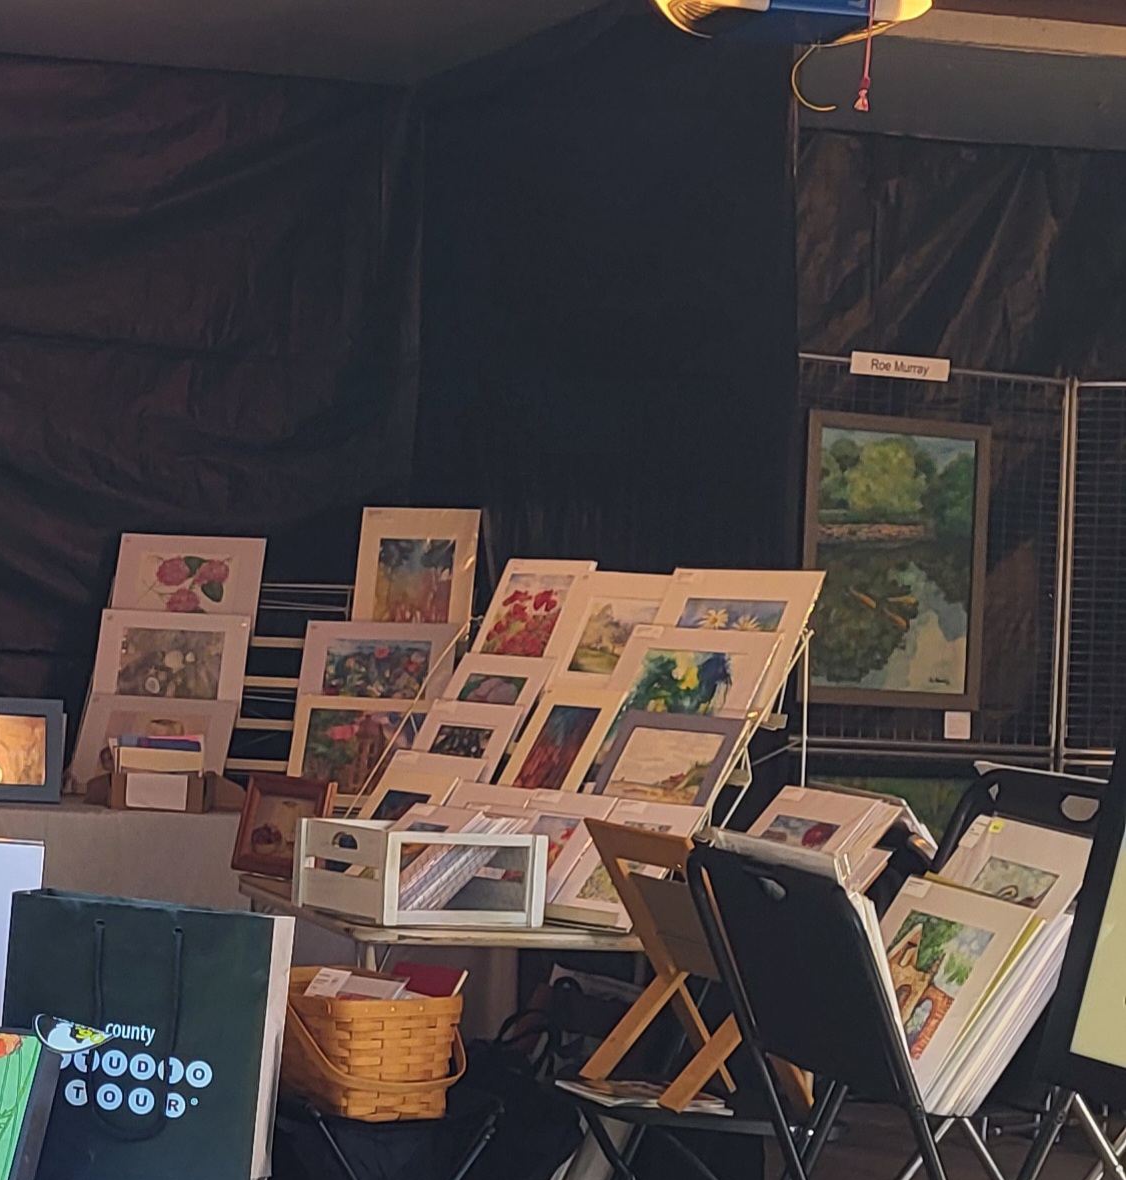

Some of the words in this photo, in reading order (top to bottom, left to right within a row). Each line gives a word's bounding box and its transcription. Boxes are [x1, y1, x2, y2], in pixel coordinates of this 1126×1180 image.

[871, 359, 891, 371] Roe
[895, 361, 929, 376] Murray
[106, 1023, 155, 1046] county
[61, 1051, 210, 1085] UDO
[69, 1083, 181, 1115] TOUR
